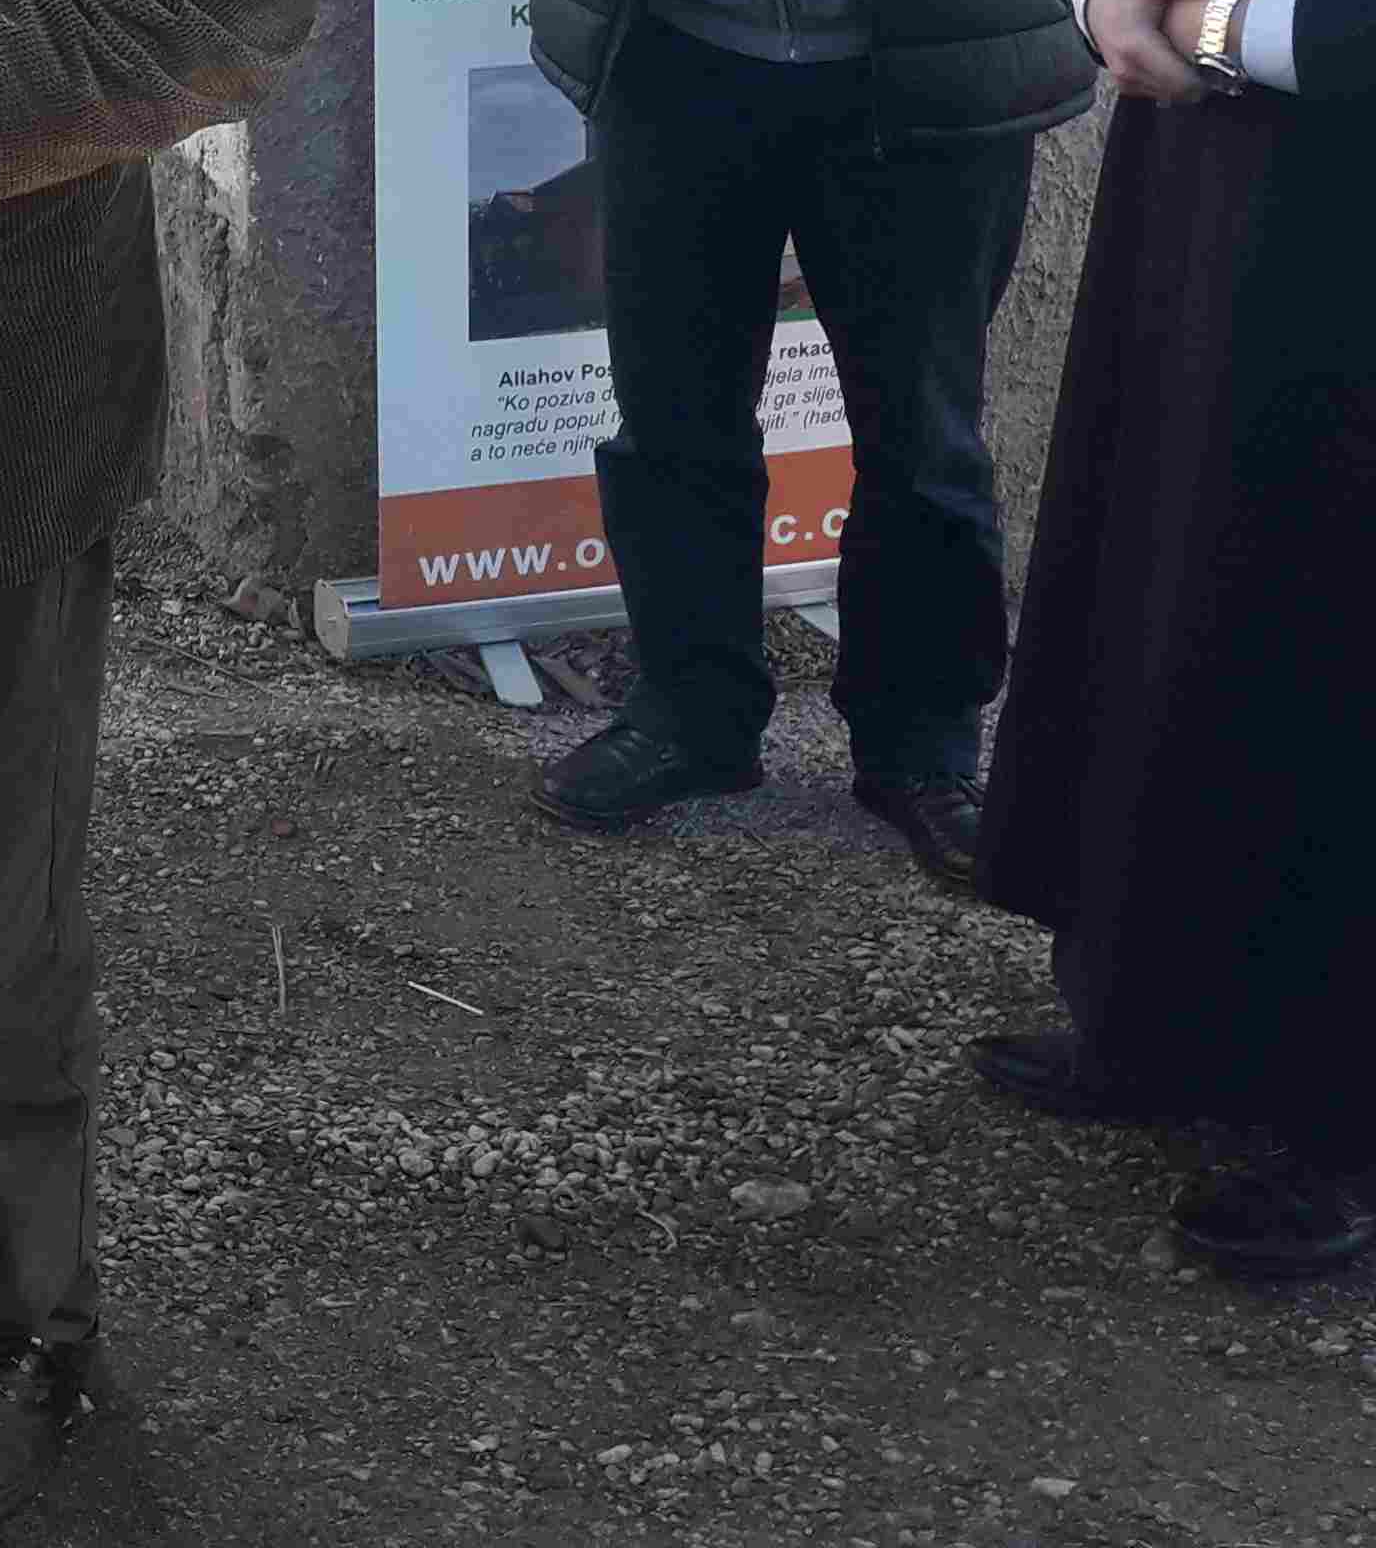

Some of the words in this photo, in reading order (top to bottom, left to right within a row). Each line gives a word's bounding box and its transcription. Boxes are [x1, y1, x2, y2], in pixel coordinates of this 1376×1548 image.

[498, 367, 575, 388] Allahov
[535, 387, 595, 412] poziva
[471, 419, 548, 441] nagradu
[553, 409, 606, 433] poput
[470, 448, 482, 462] a
[488, 443, 506, 461] to
[511, 439, 556, 458] neće
